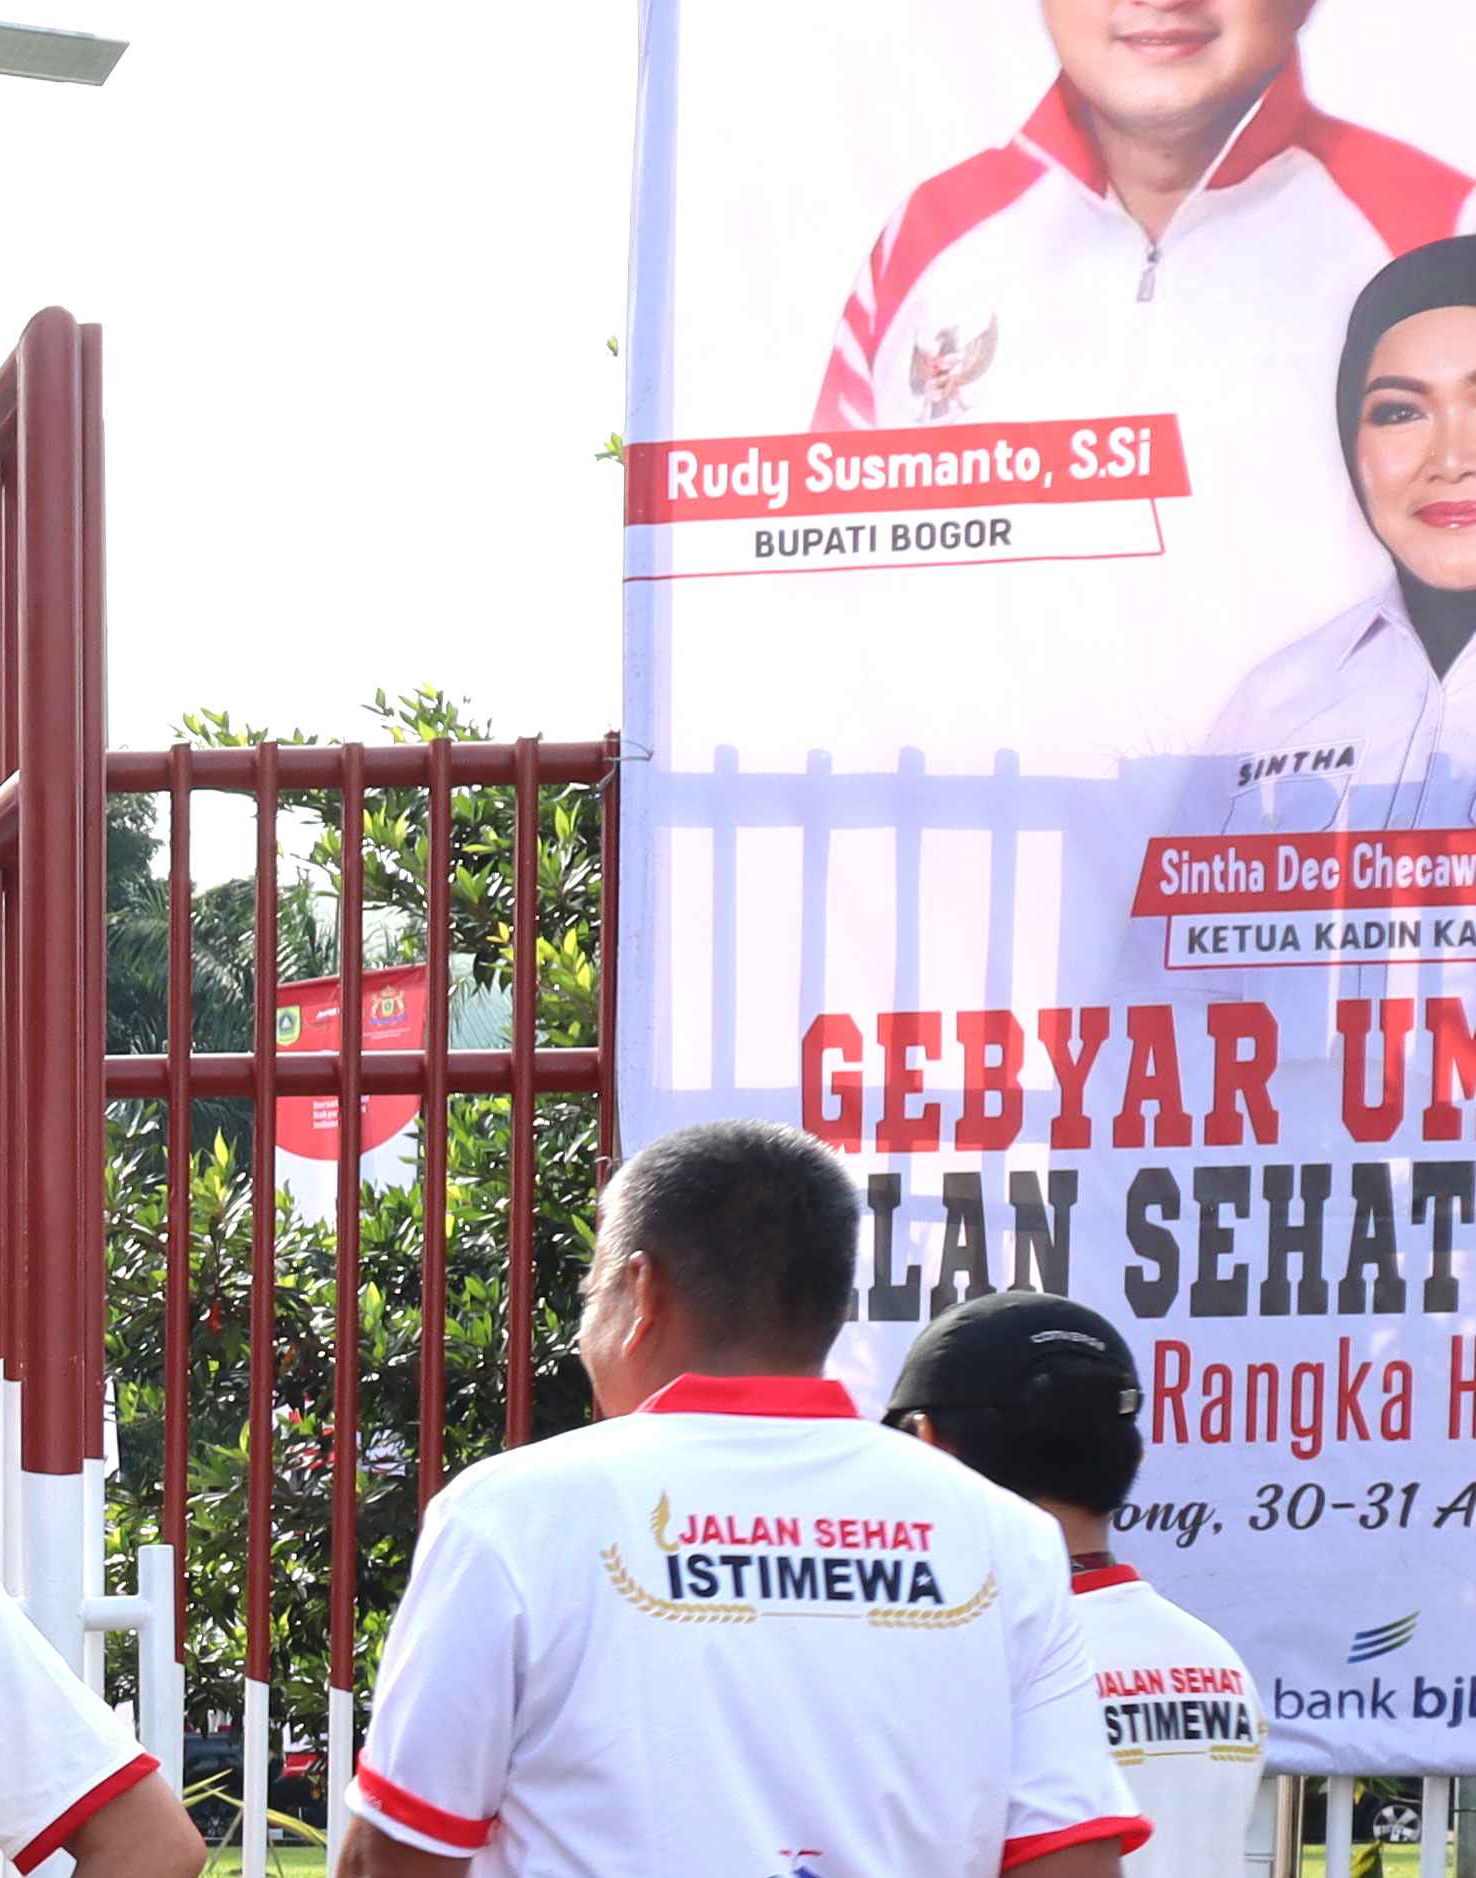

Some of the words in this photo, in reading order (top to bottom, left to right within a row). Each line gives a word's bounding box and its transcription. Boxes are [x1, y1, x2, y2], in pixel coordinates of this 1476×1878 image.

[667, 449, 789, 508] Rudy
[804, 432, 1054, 495] Susmanto,
[1069, 426, 1153, 479] S.Si
[754, 525, 878, 559] BUPATI
[890, 517, 1013, 552] BOGOR
[1238, 744, 1358, 788] SINTHA
[1160, 846, 1267, 896] Sintha
[1276, 844, 1340, 892] Dec
[1187, 923, 1300, 954] KETUA
[1314, 919, 1422, 950] KADIN
[801, 1002, 1279, 1155] GEBYAR
[1124, 1162, 1476, 1320] SEHAT
[1152, 1337, 1414, 1460] Rangka
[1248, 1480, 1420, 1534] 30-31
[678, 1513, 801, 1547] JALAN
[814, 1518, 934, 1552] SEHAT
[665, 1553, 945, 1605] ISTIMEWA
[1095, 1668, 1166, 1700] JALAN
[1170, 1667, 1245, 1696] SEHAT
[1274, 1677, 1398, 1722] bank
[1104, 1700, 1254, 1746] STIMEWA
